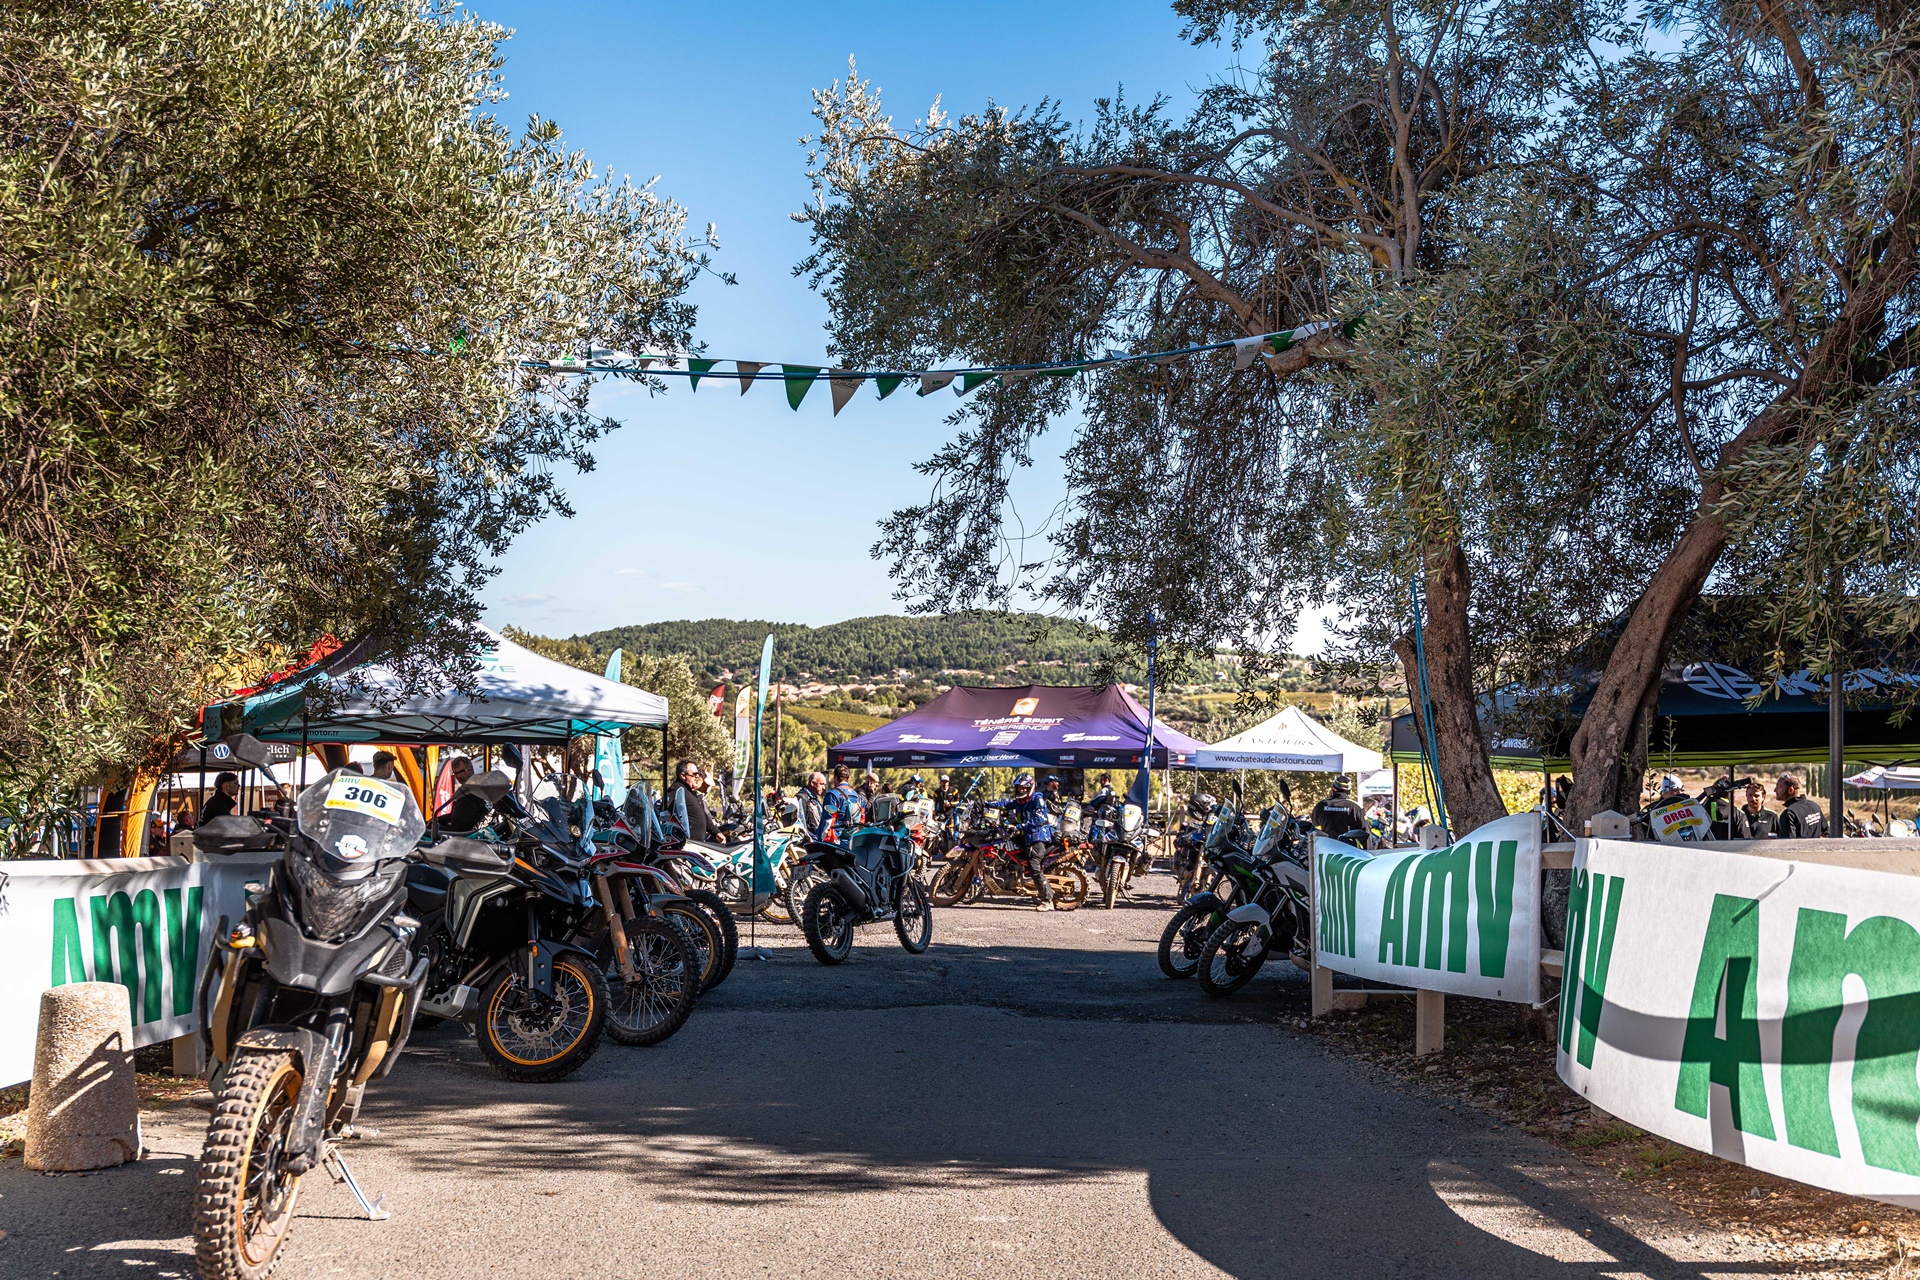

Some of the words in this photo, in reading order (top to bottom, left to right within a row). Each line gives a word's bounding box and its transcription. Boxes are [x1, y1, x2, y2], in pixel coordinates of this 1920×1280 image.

[287, 729, 340, 737] kovmotor.fr
[978, 724, 1051, 732] EXPERIENCE
[1214, 754, 1324, 765] www.chateaudelastours.com
[344, 786, 388, 809] 306
[1663, 808, 1694, 825] ORGA
[1379, 840, 1518, 979] AMV
[51, 886, 204, 1027] AMV
[1558, 867, 1625, 1070] MV
